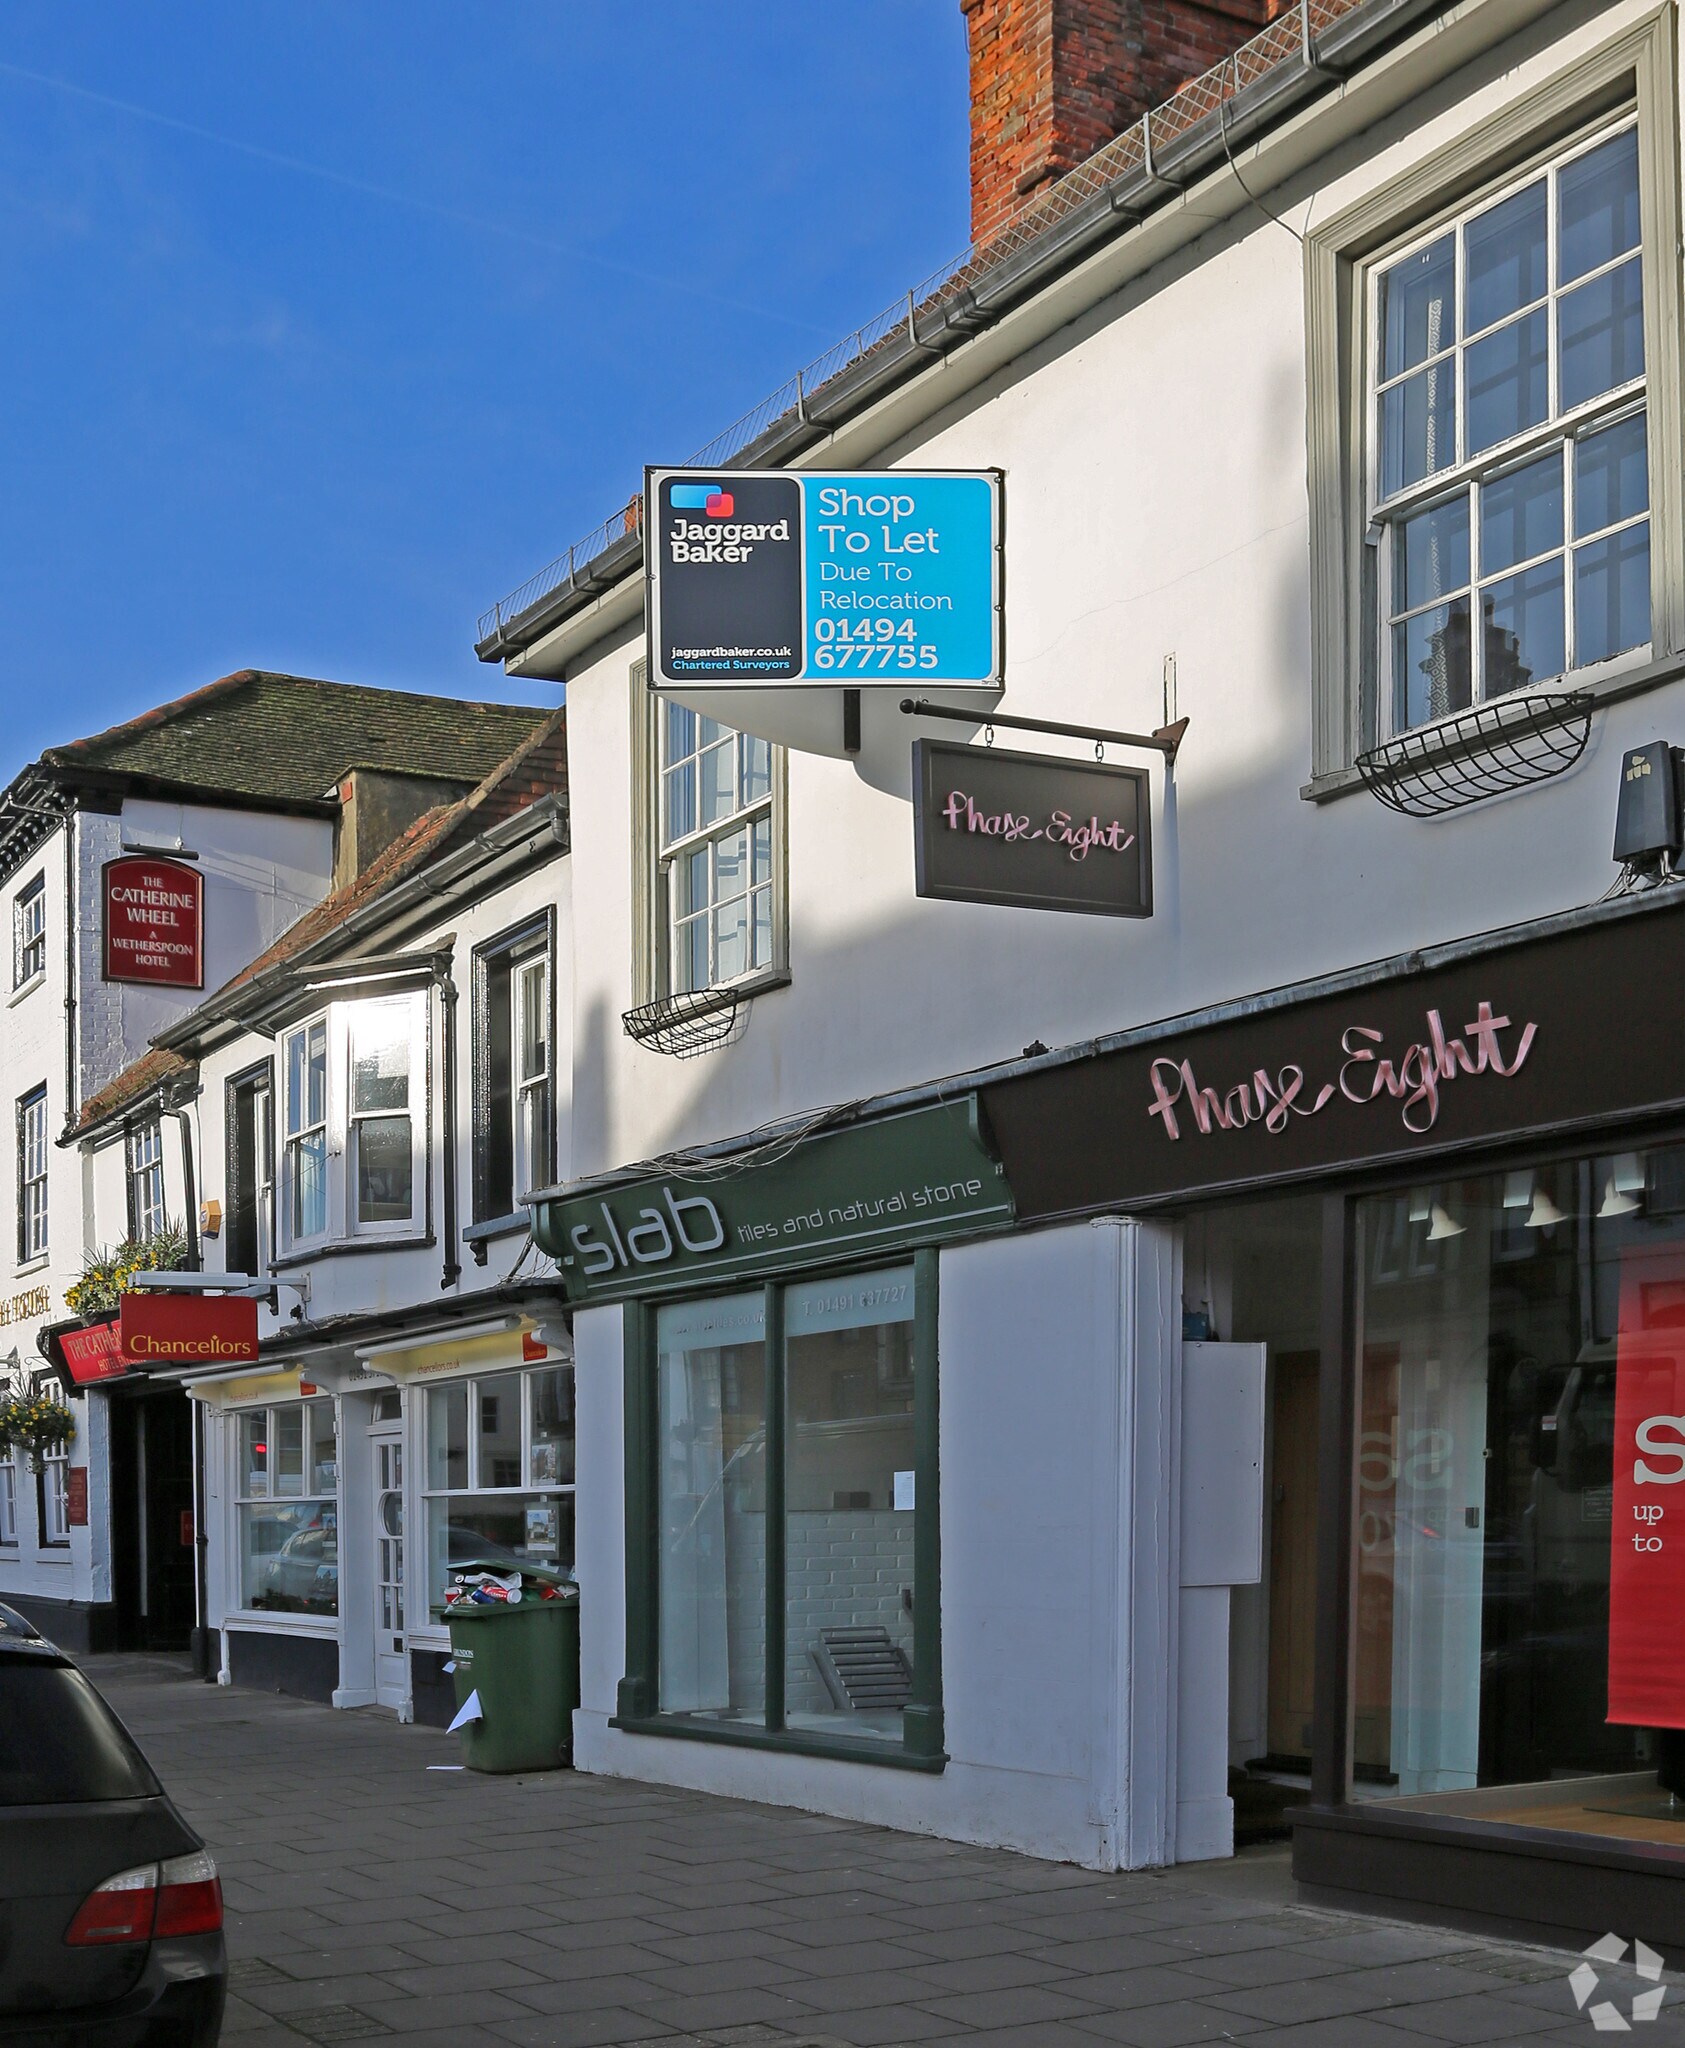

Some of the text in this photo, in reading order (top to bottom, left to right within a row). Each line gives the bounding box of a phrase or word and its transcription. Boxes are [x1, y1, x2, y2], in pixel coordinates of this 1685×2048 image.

[818, 487, 915, 522] Shop
[670, 519, 790, 546] Jaggard
[818, 525, 940, 554] To Let
[671, 541, 753, 563] Baker
[820, 562, 913, 582] Due To
[820, 589, 953, 611] Relocation
[814, 617, 918, 642] 01494
[670, 646, 792, 660] jaggardbaker.co.uk
[814, 644, 939, 669] 677755
[672, 659, 790, 671] Chartered Surveyors
[942, 790, 1135, 862] Phase Eight
[142, 876, 164, 888] THE
[111, 887, 194, 909] CATHERINE
[126, 907, 179, 927] WHEEL
[112, 937, 194, 955] WETHERSPOON
[149, 931, 157, 939] A
[135, 954, 171, 968] HOTEL
[1147, 1001, 1539, 1141] Phase Eight
[737, 1177, 982, 1244] tiles and natural stone
[570, 1186, 725, 1276] slab
[67, 1338, 88, 1361] THE
[130, 1334, 251, 1355] Chancellors
[1632, 1505, 1664, 1526] up
[1632, 1533, 1663, 1552] to
